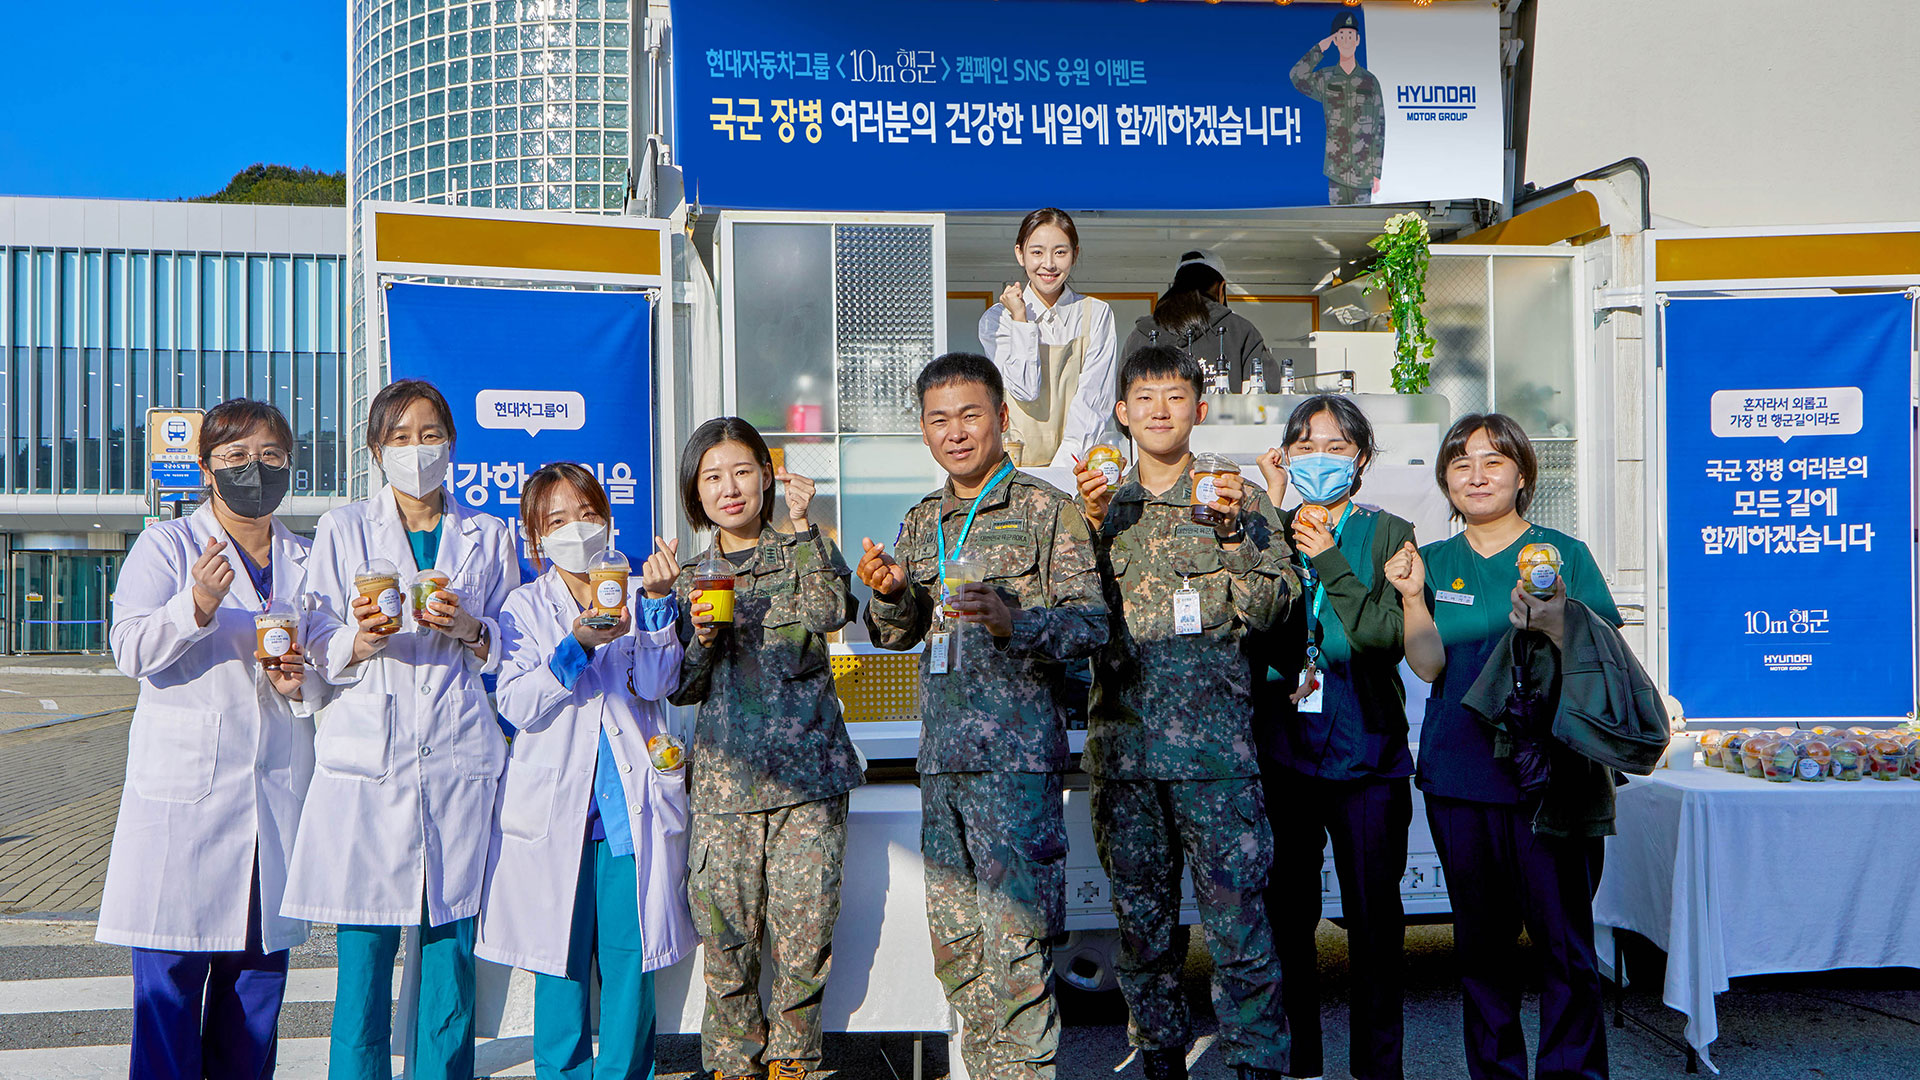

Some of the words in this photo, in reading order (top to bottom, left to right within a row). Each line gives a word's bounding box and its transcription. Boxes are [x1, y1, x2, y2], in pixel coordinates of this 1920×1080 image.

[705, 48, 831, 81] 현대자동차그룹
[956, 56, 1009, 84] 캠페인
[1013, 59, 1051, 82] SNS
[1055, 57, 1090, 87] 응원
[1094, 59, 1147, 87] 이벤트
[1397, 85, 1476, 103] HYUNDAI
[709, 97, 764, 141] 국군
[770, 98, 822, 144] 장병
[831, 99, 937, 143] 여러분의
[945, 102, 1024, 146] 건강한
[1031, 103, 1109, 145] 내일에
[1115, 104, 1301, 146] 함께하겠습니다!
[1406, 112, 1436, 121] MOTOR
[1438, 112, 1468, 121] GROUP
[494, 402, 569, 418] 현대차그룹이
[1743, 397, 1789, 411] 혼자라서
[1792, 397, 1828, 411] 외롭고
[1730, 413, 1753, 428] 가장
[1756, 413, 1768, 428] 먼
[1771, 412, 1840, 428] 행군길이라도
[1705, 459, 1742, 482] 국군
[1746, 458, 1783, 482] 장병
[1788, 456, 1868, 480] 여러분의
[1733, 489, 1782, 517] 모든
[1786, 488, 1837, 517] 길에
[1701, 523, 1875, 555] 함께하겠습니다
[1764, 654, 1812, 663] HYUNDAI
